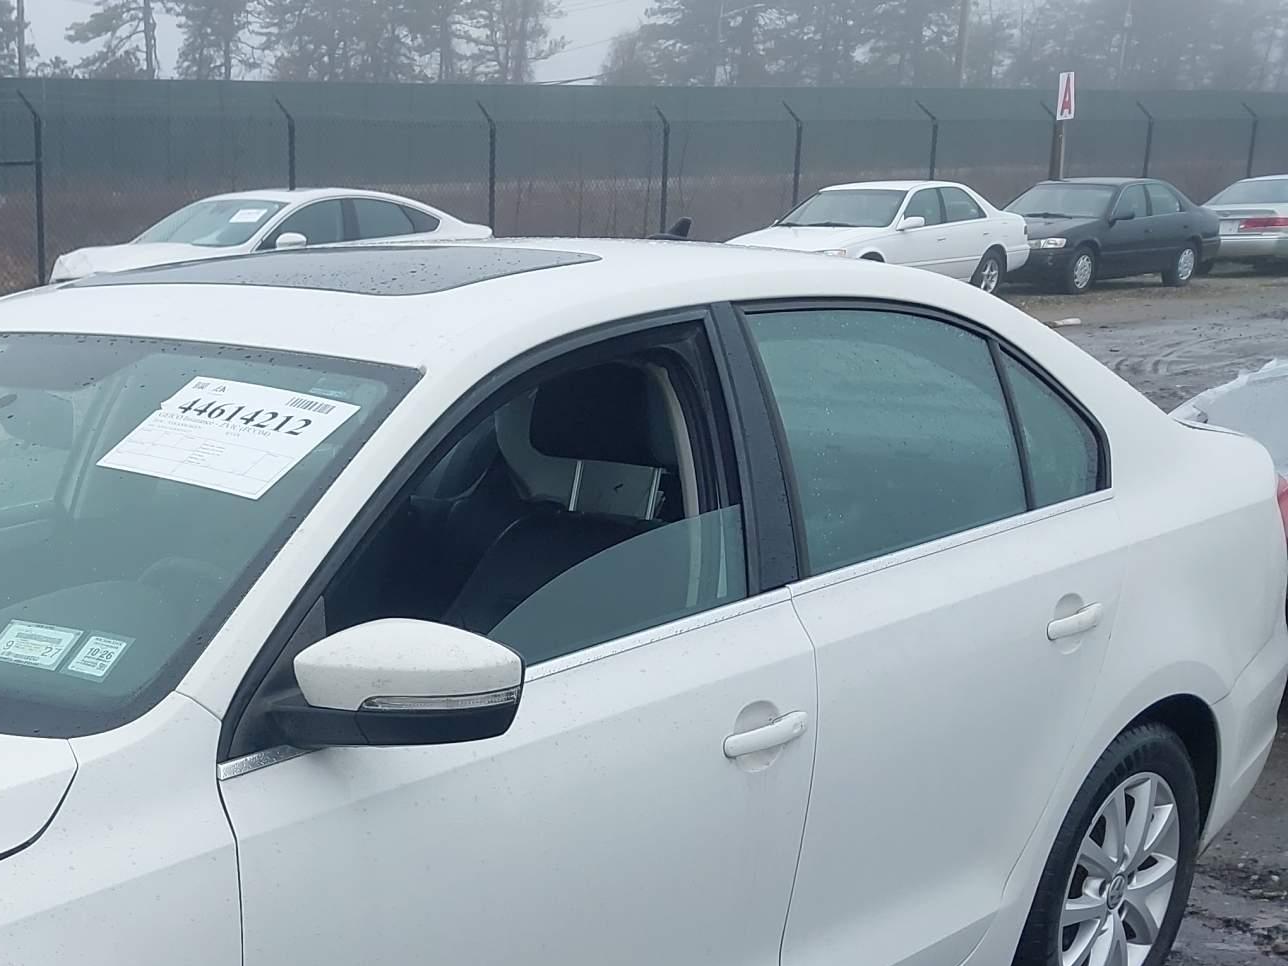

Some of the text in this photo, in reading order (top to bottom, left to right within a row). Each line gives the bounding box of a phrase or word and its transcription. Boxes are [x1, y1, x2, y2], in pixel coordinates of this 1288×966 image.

[1060, 72, 1072, 116] A
[178, 398, 312, 436] 44614212
[41, 646, 63, 658] 27
